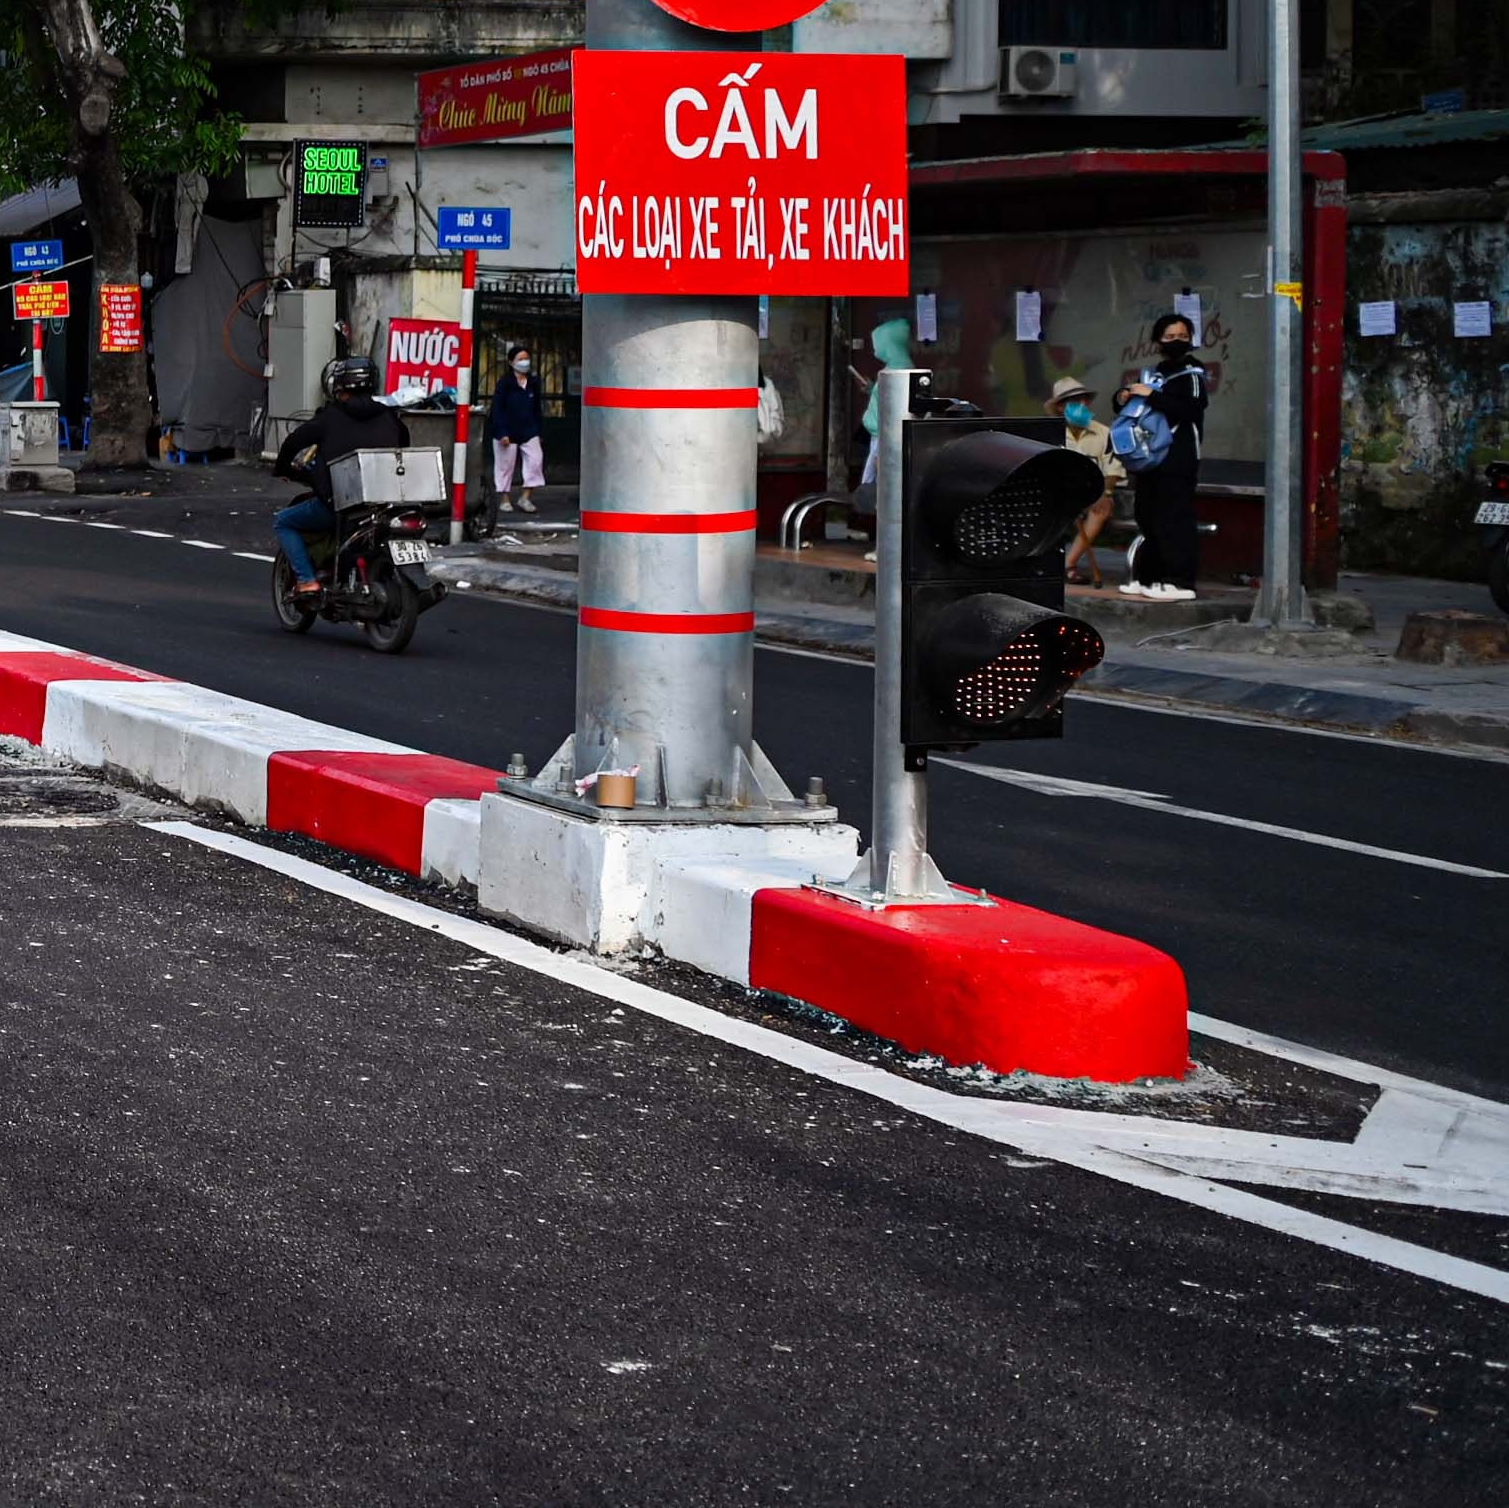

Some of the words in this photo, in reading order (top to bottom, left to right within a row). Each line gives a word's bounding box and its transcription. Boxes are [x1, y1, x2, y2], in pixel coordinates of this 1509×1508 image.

[439, 98, 477, 130] Chúc
[664, 63, 819, 160] CẤM
[304, 147, 361, 171] SEOUL
[304, 172, 359, 195] HOTEL
[579, 180, 624, 259] CÁC
[632, 195, 681, 269] LOẠI
[689, 196, 721, 259] XE
[731, 176, 774, 270] TẢI,
[780, 197, 810, 260] XE
[823, 183, 904, 260] KHÁCH
[390, 327, 459, 367] NƯỚC
